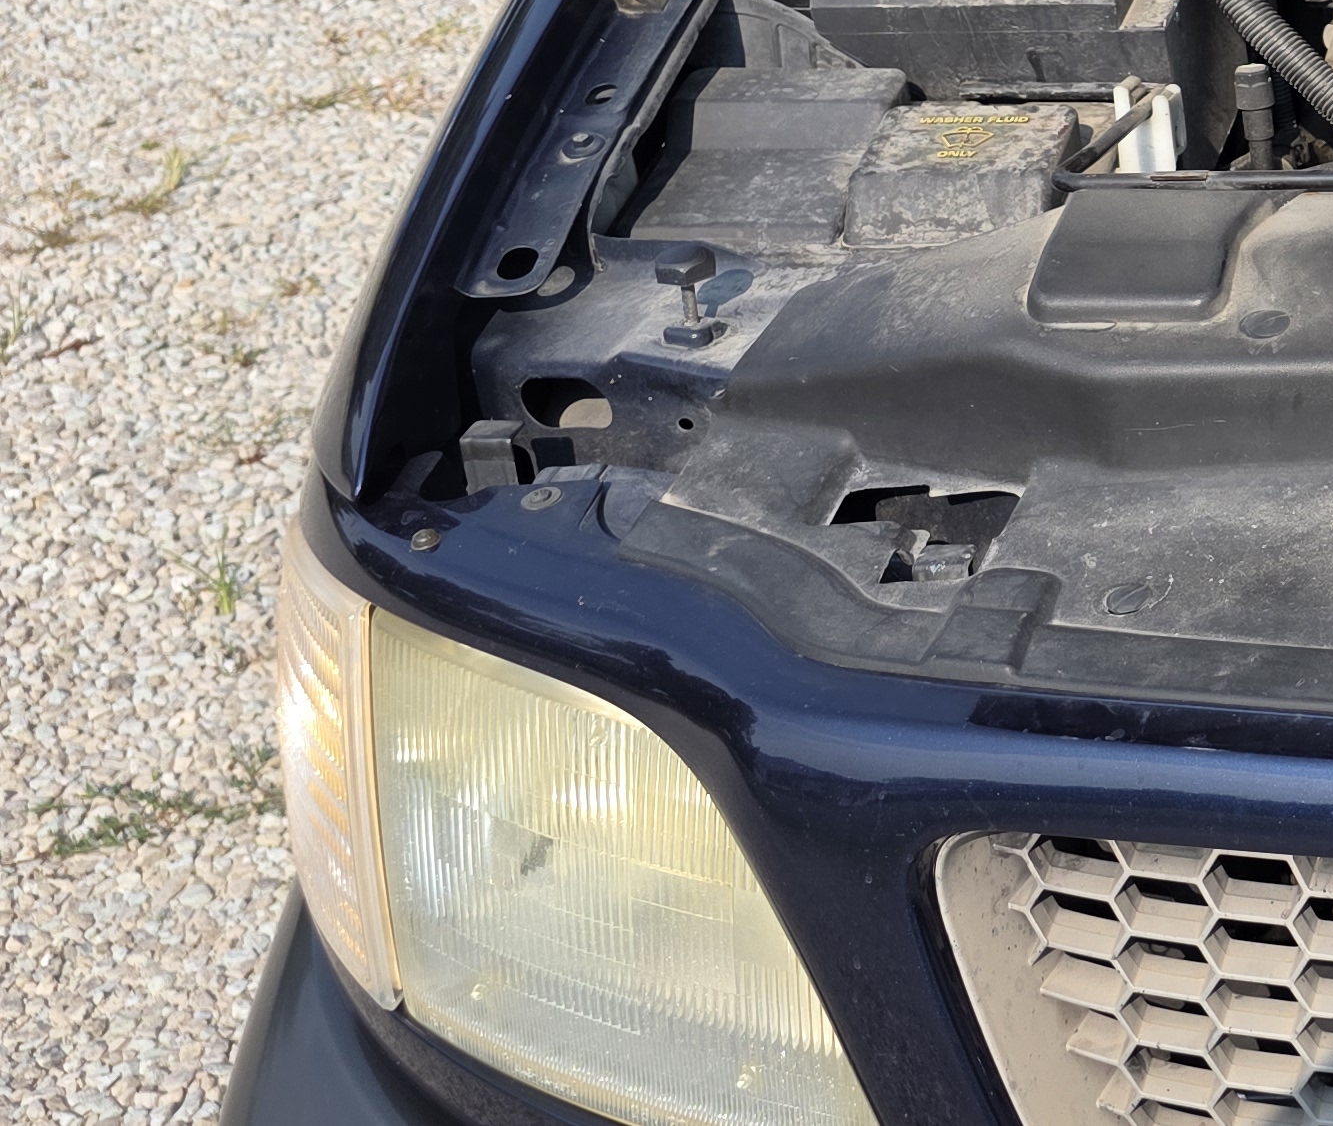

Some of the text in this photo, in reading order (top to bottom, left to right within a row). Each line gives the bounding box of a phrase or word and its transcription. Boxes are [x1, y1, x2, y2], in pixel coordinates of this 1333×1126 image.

[919, 115, 1030, 124] WASHER FLUID
[936, 150, 977, 158] ONLY
